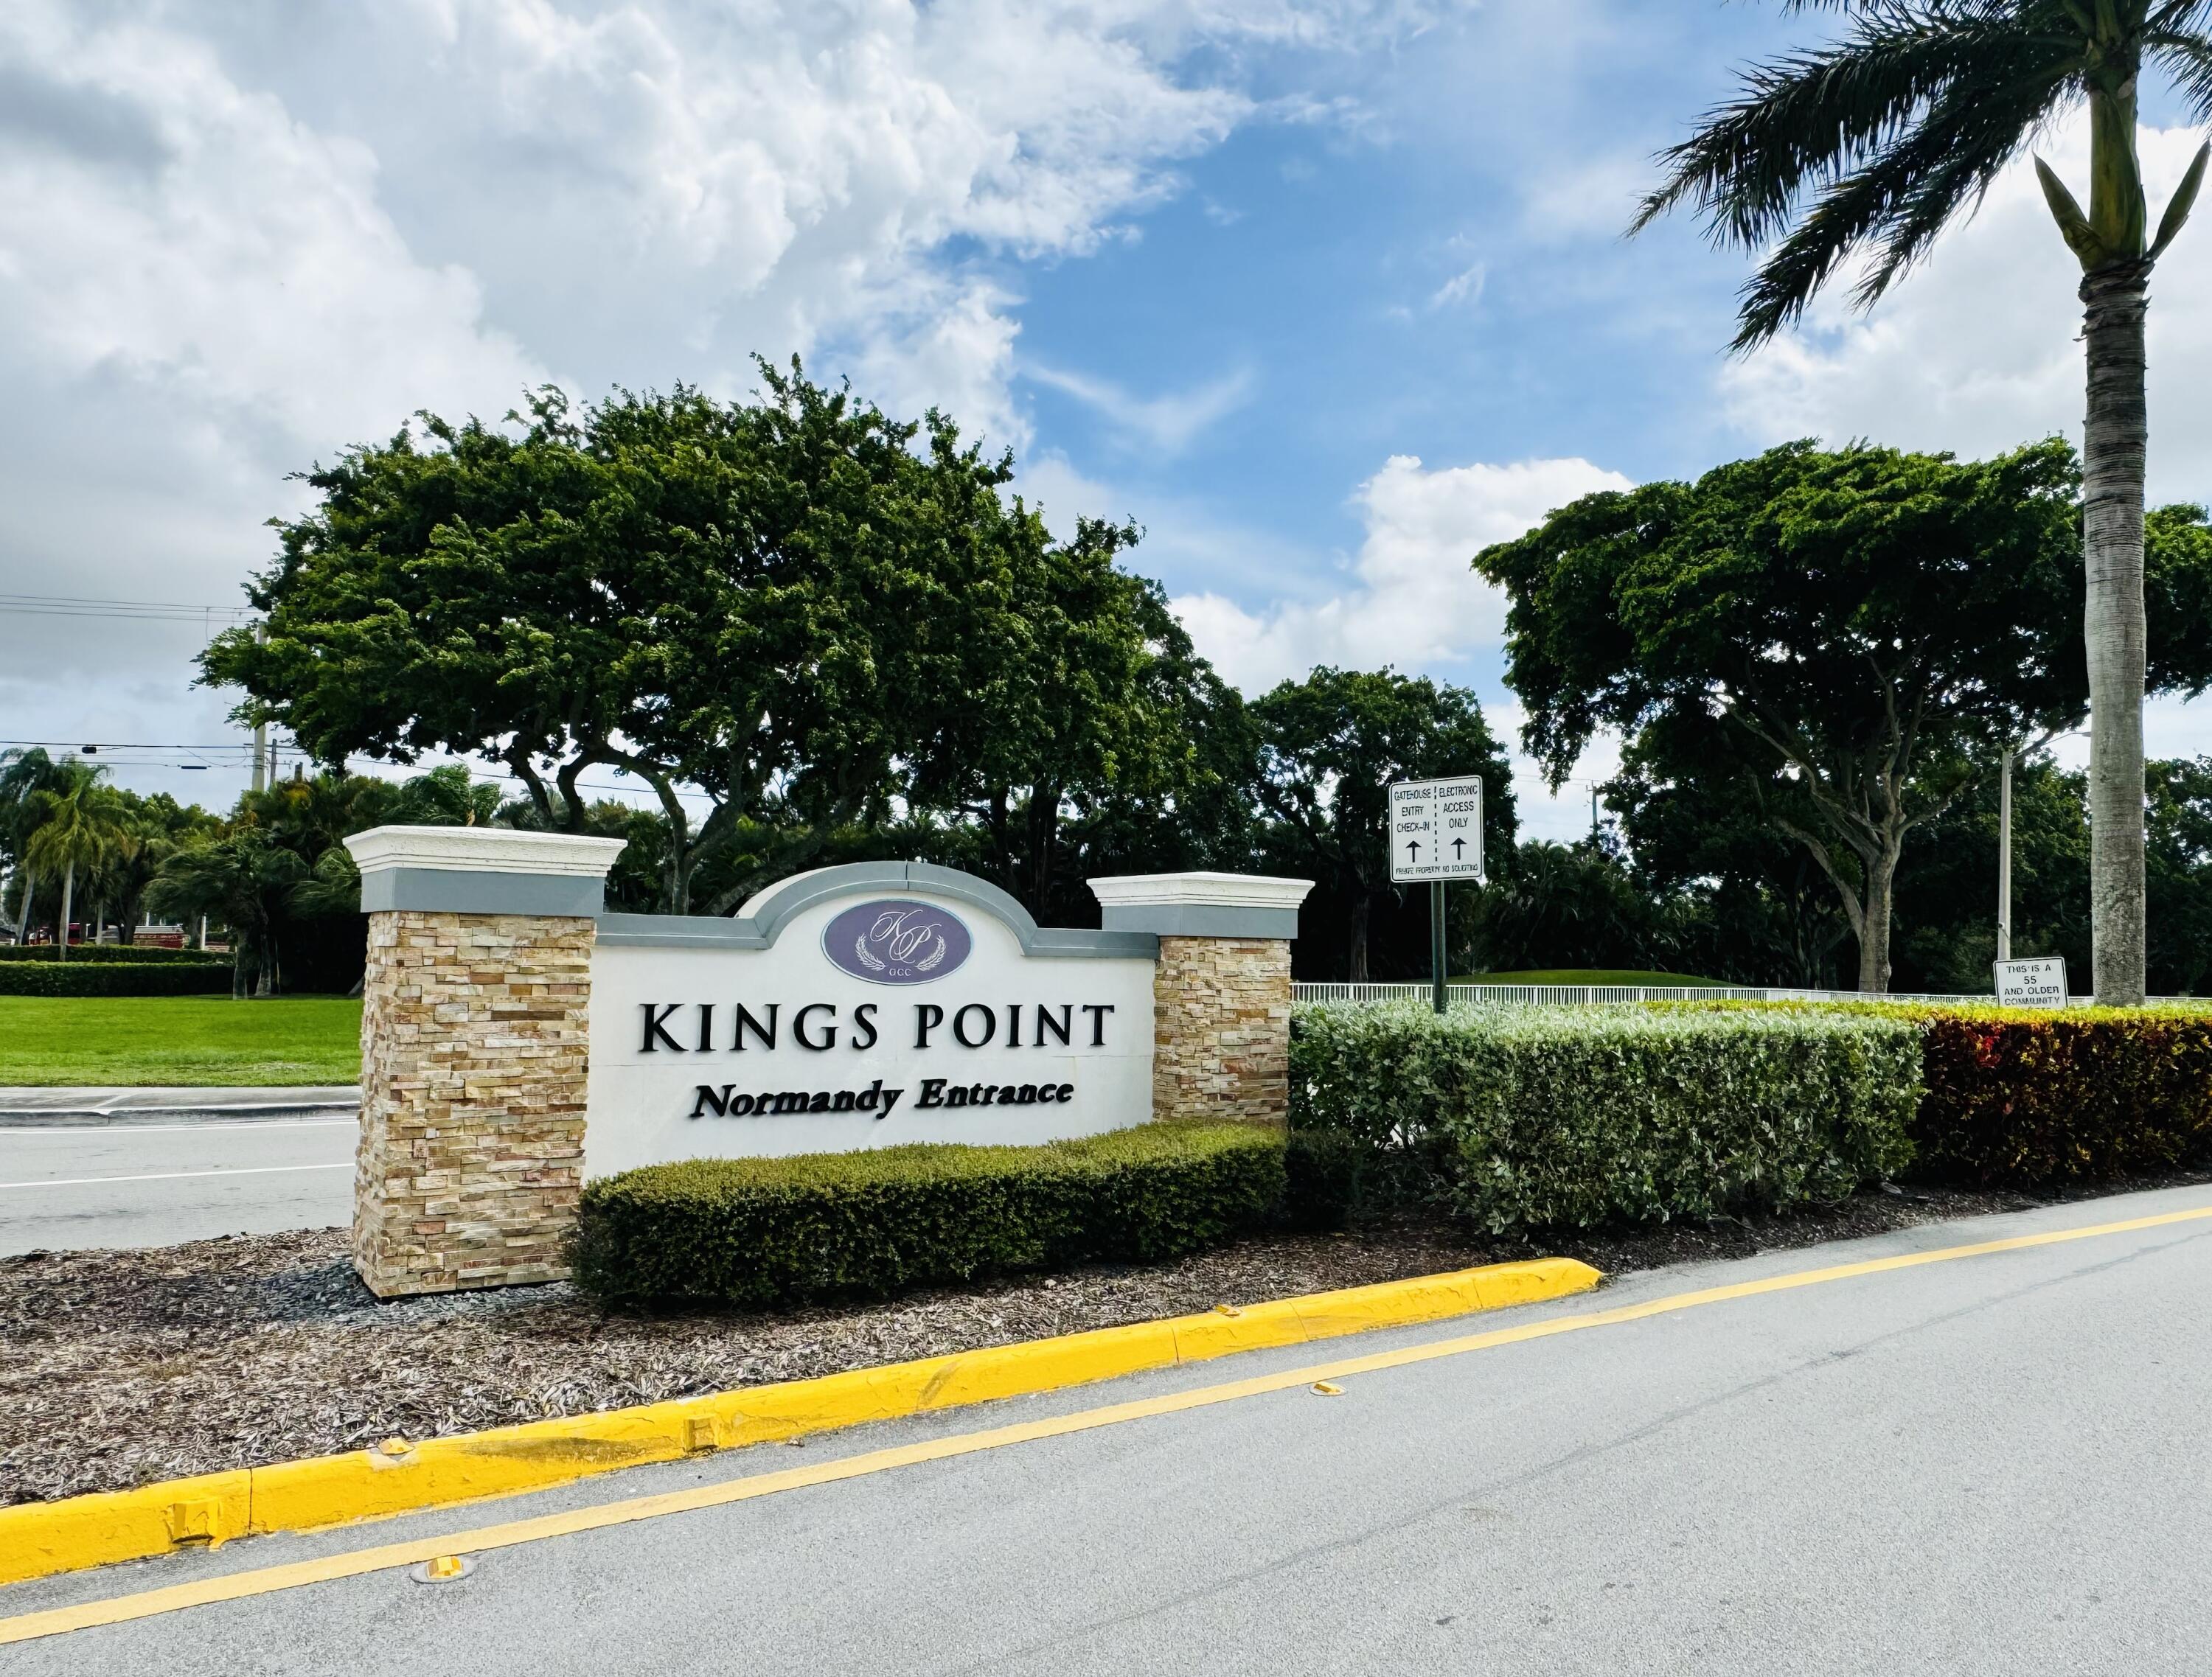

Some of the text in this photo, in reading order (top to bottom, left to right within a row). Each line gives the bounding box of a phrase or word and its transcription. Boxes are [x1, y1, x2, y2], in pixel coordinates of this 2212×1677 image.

[1439, 785, 1478, 797] ELECTRONIC
[1402, 806, 1424, 816] ENTRY
[1443, 801, 1474, 813] ACCESS
[1397, 821, 1430, 832] CHECK-IN
[1449, 817, 1468, 828] ONLY
[2031, 964, 2039, 972] IS
[2024, 976, 2037, 984] 55
[2028, 986, 2059, 994] OLDER
[2005, 997, 2059, 1005] COMMUNITY
[638, 1003, 1115, 1053] KINGS POINT
[689, 1078, 1074, 1120] Normandy Entrance
